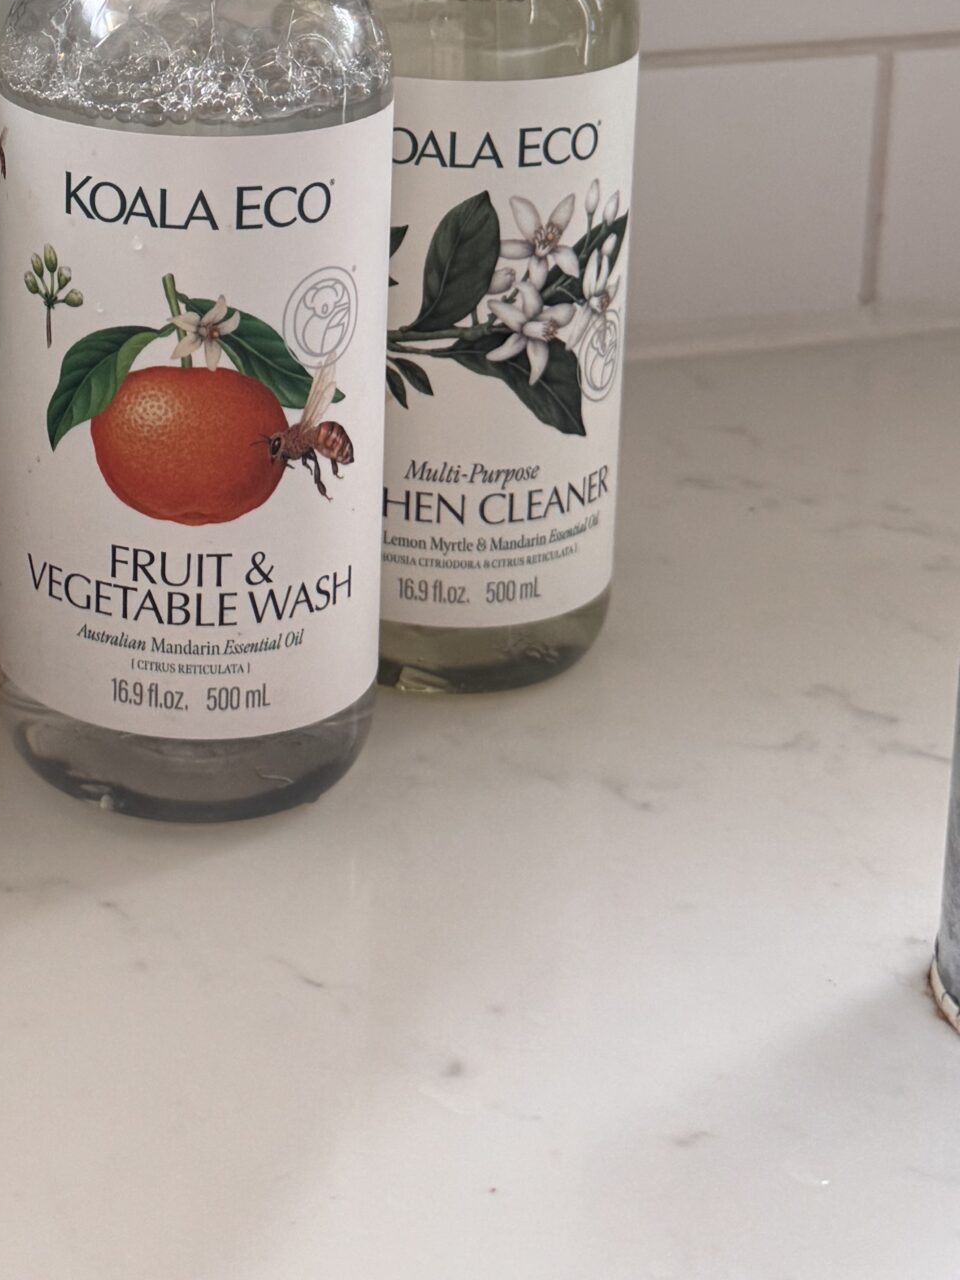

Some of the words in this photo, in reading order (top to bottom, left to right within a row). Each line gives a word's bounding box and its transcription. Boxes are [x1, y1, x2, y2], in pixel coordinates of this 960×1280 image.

[392, 126, 503, 168] OALA
[64, 171, 219, 231] KOALA
[404, 459, 540, 490] Multi-Purpose
[478, 465, 608, 525] CLEANER
[383, 530, 426, 550] Lemon
[430, 536, 473, 556] Myrtle
[476, 537, 487, 552] &
[489, 534, 547, 552] Mandarin
[548, 517, 588, 543] Essential
[110, 544, 233, 587] FRUIT
[245, 551, 274, 585] &
[418, 556, 480, 569] CITRIODORA
[491, 557, 525, 568] CITRUS
[27, 552, 238, 627] VEGETABLE
[248, 564, 352, 624] WASH
[397, 577, 428, 601] 16.9
[432, 579, 470, 604] fl.oz.
[486, 580, 516, 604] 500
[520, 576, 541, 600] mL
[76, 623, 146, 651] Australian
[150, 637, 221, 656] Mandarin
[223, 634, 282, 655] Essential
[284, 628, 305, 648] Oil
[137, 659, 176, 673] CITRUS
[178, 663, 245, 675] RETICULATA
[111, 678, 143, 706] 16.9
[147, 682, 189, 711] fl.oz.
[206, 686, 241, 711] 500
[245, 683, 271, 709] mL
